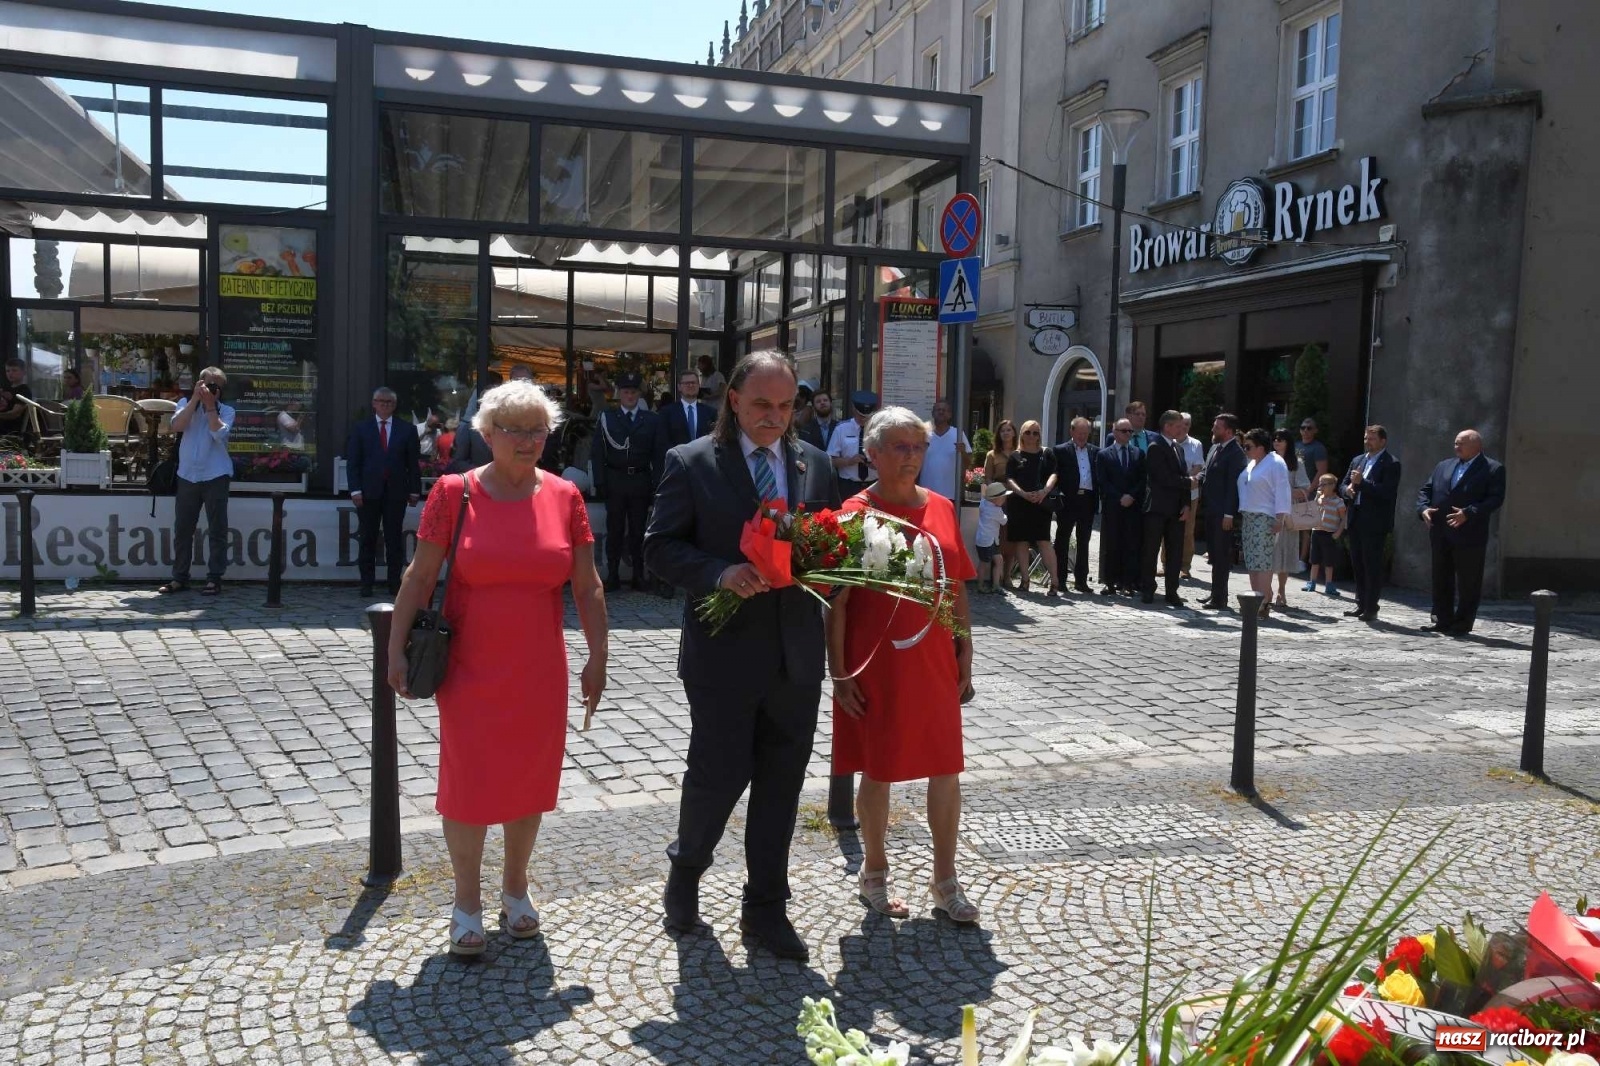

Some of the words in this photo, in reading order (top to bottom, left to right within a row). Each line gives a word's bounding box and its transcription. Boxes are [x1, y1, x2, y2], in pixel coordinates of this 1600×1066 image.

[1129, 222, 1211, 274] Browar
[1273, 156, 1382, 243] Rynek
[221, 277, 260, 295] CATERING
[262, 279, 315, 298] DIETETYCZNY
[261, 302, 276, 313] BEZ
[277, 303, 313, 315] PSZENICY
[891, 302, 932, 315] LUNCH
